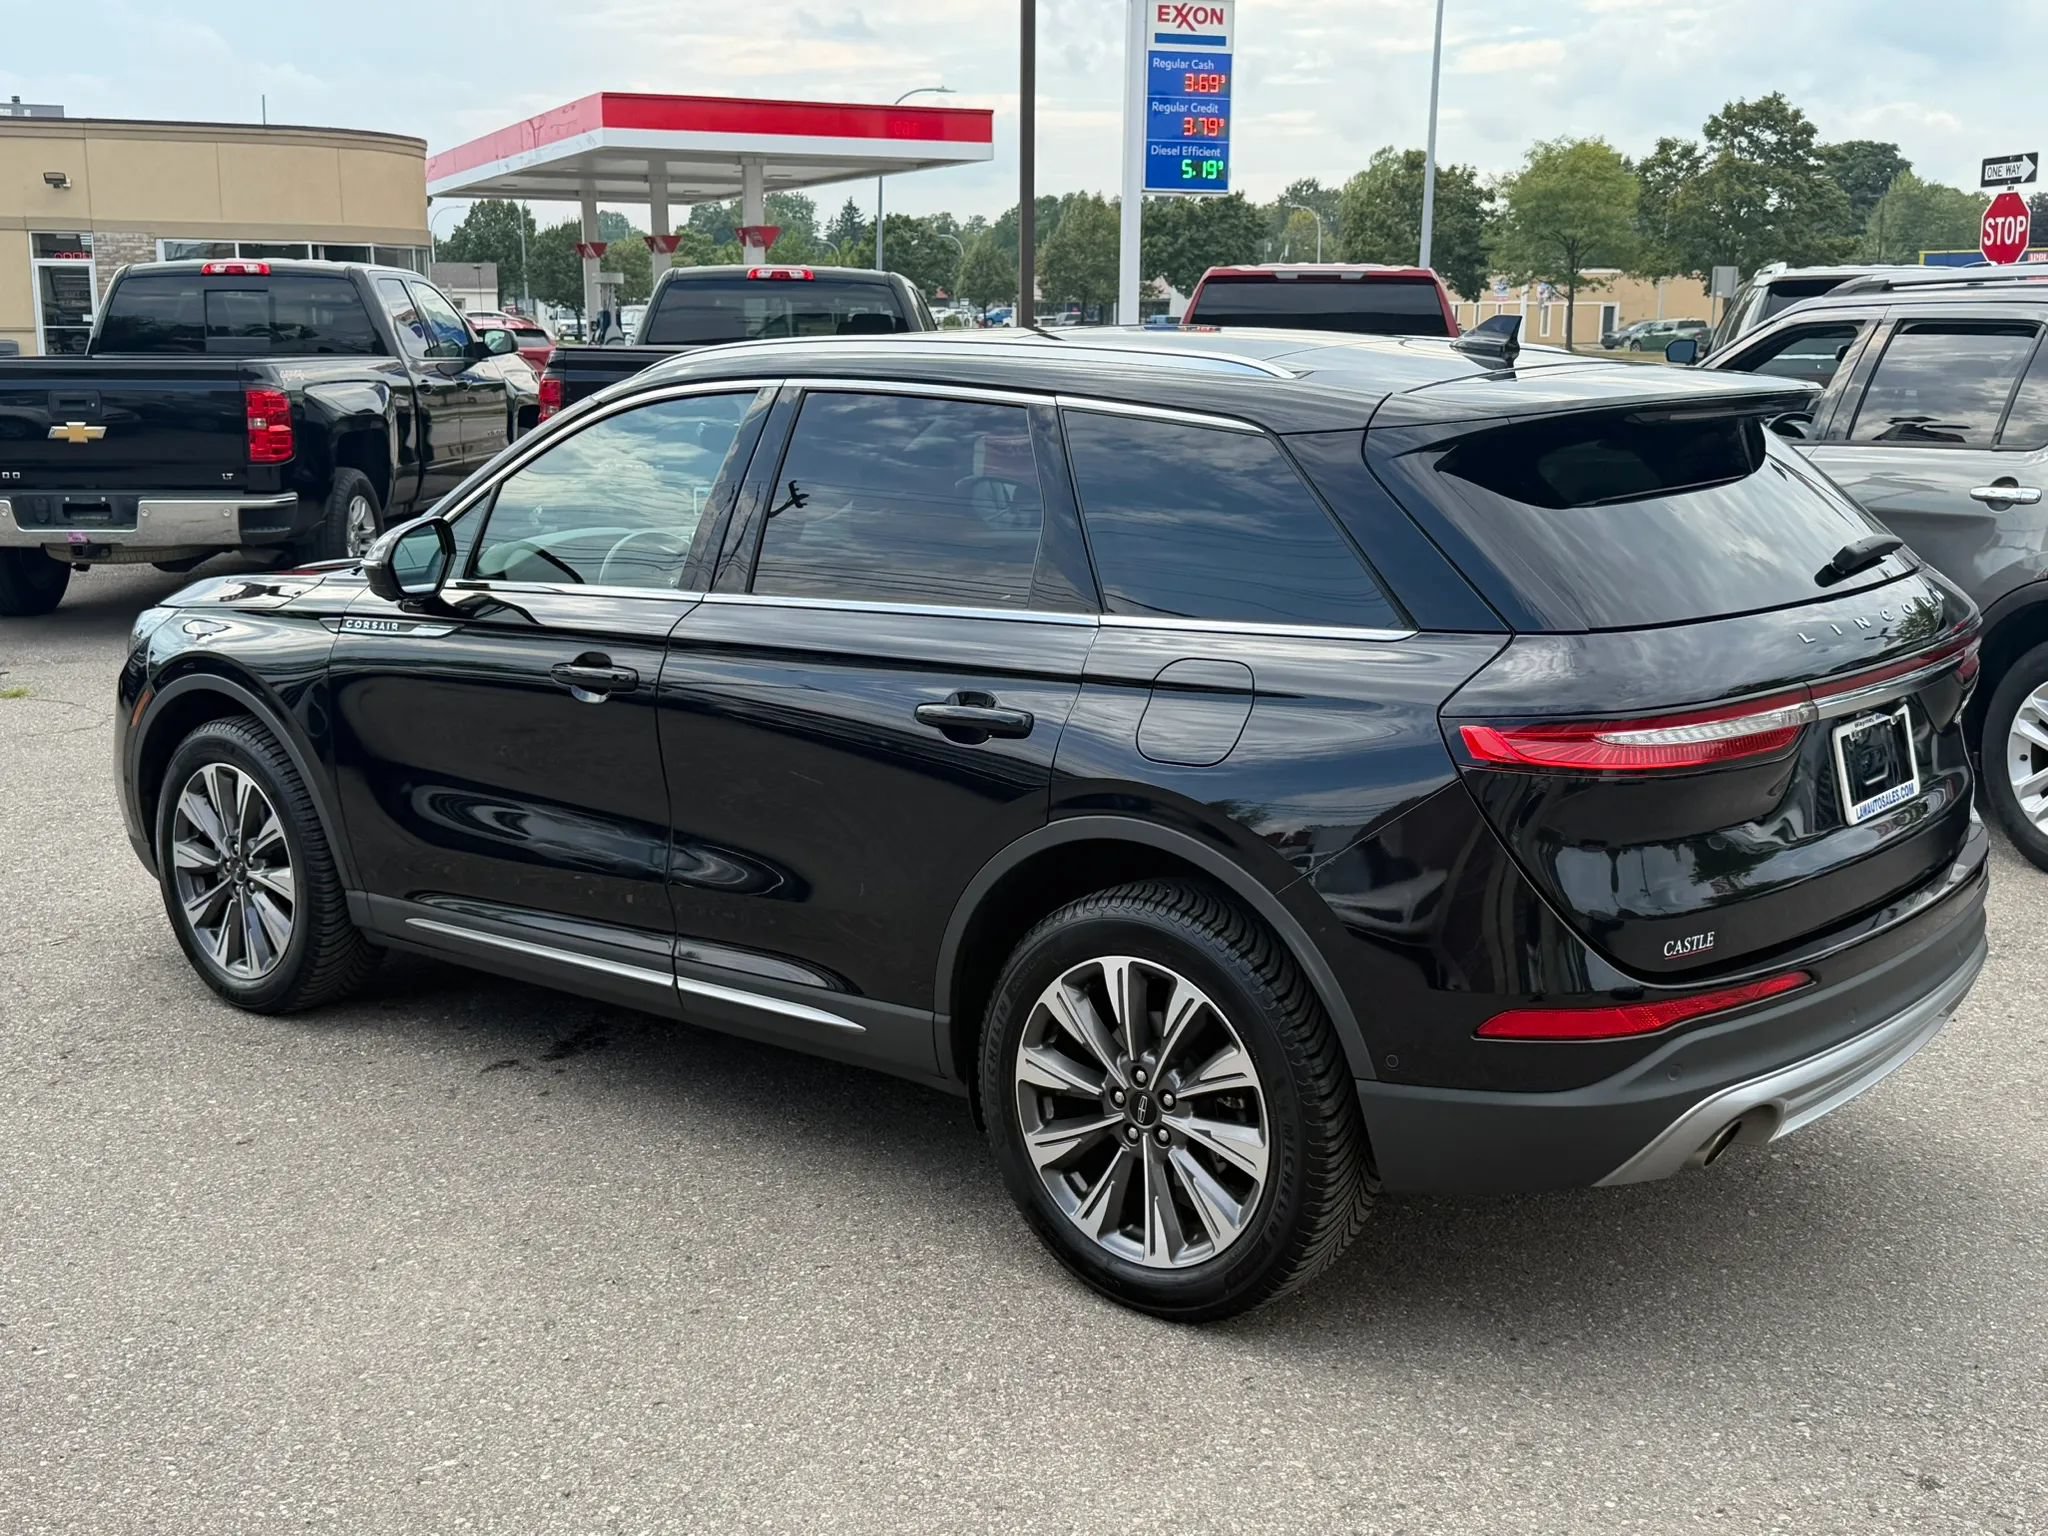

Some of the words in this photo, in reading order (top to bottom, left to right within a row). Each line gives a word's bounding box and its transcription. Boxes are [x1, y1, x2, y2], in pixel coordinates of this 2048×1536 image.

[1157, 3, 1224, 32] EXXON
[1152, 58, 1189, 71] Regular
[1191, 60, 1215, 70] Cash
[1151, 101, 1188, 114] Regular
[1190, 103, 1219, 113] Credit
[1150, 145, 1180, 156] Diesel
[1181, 146, 1221, 157] Efficient
[1986, 166, 2003, 178] ONE
[2005, 163, 2022, 176] WAY
[1984, 215, 2027, 246] STOP
[1797, 590, 1945, 644] LINCOLN
[345, 619, 399, 631] CORSAIR
[1663, 931, 1715, 956] CASTLE
